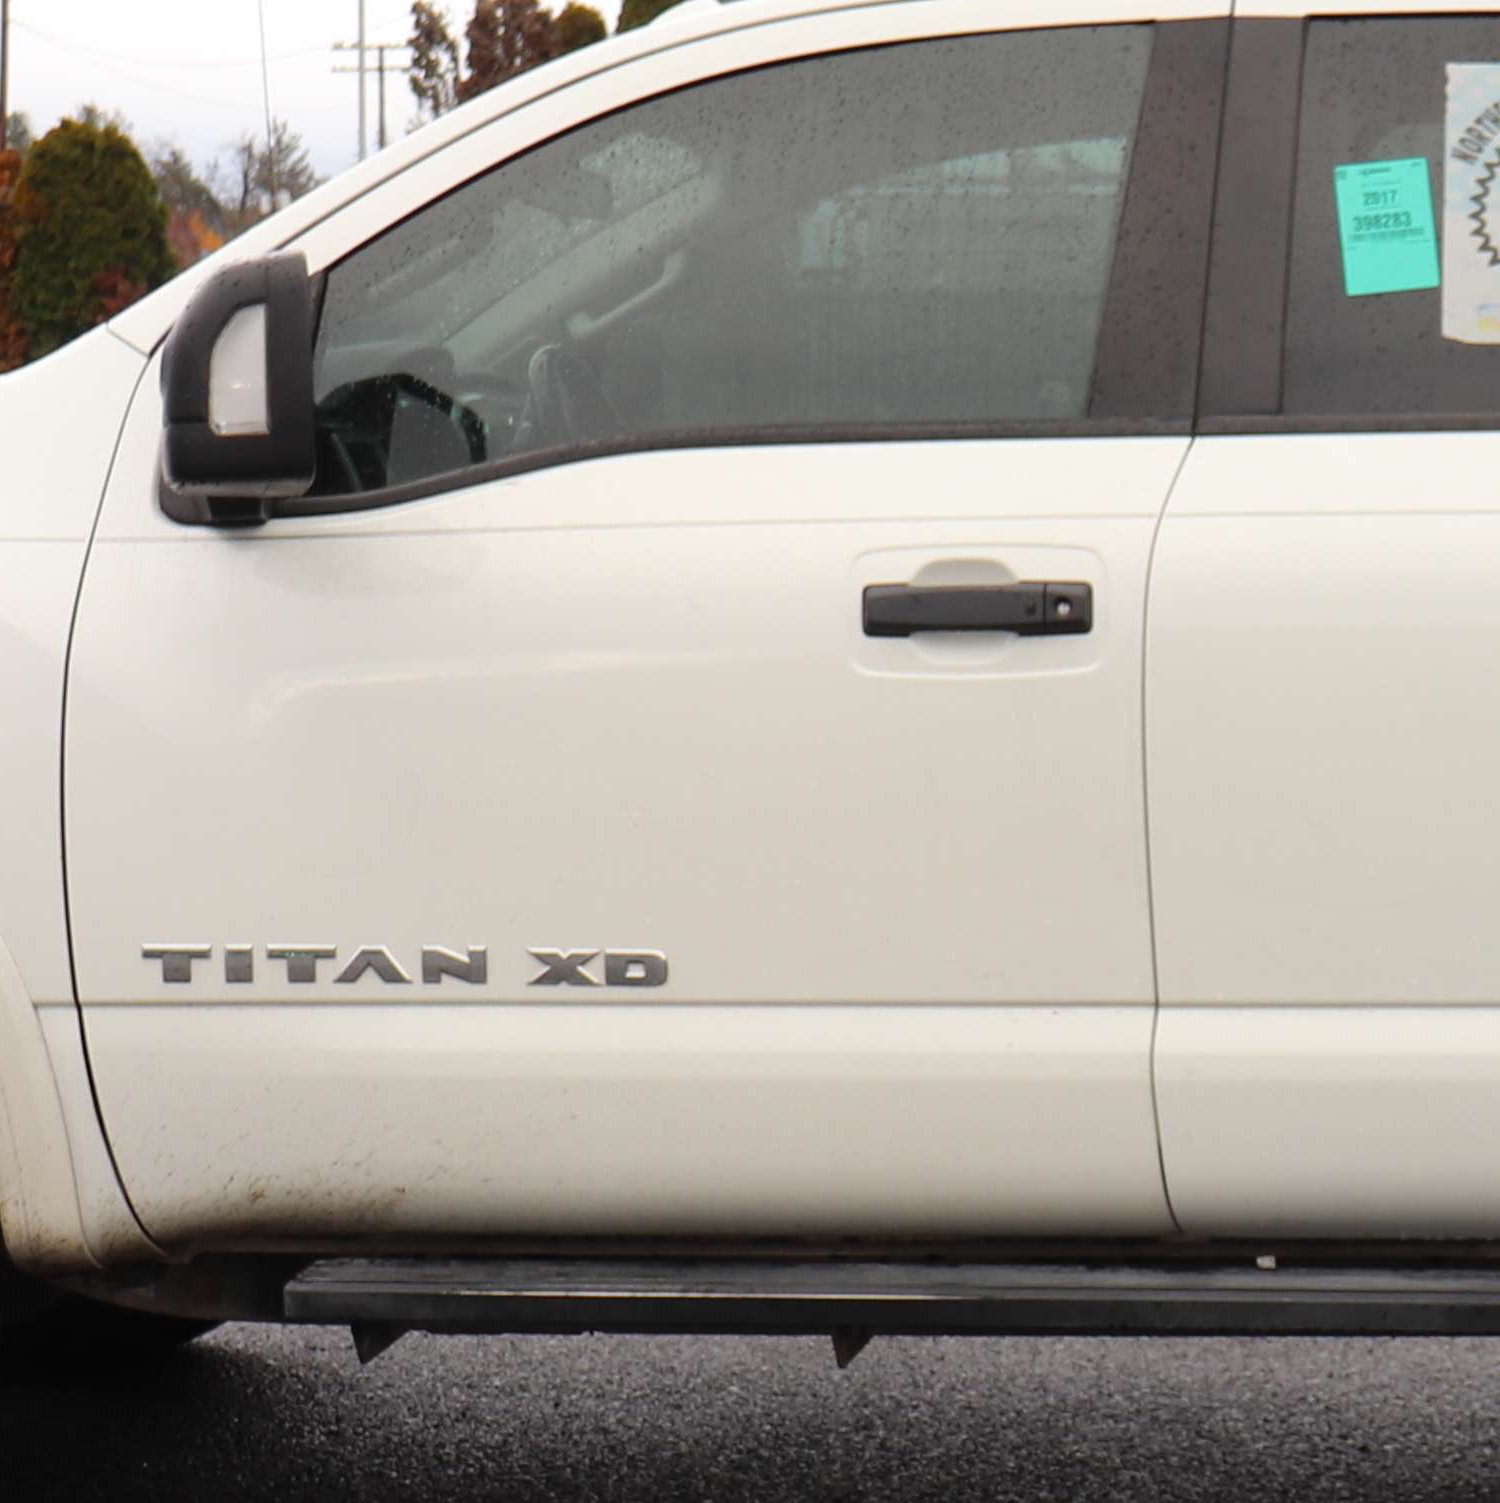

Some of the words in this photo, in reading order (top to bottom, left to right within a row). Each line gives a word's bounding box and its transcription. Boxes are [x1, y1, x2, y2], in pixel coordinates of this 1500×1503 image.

[1362, 189, 1398, 206] 2017
[141, 942, 487, 985] TITAN
[525, 946, 669, 987] XD
